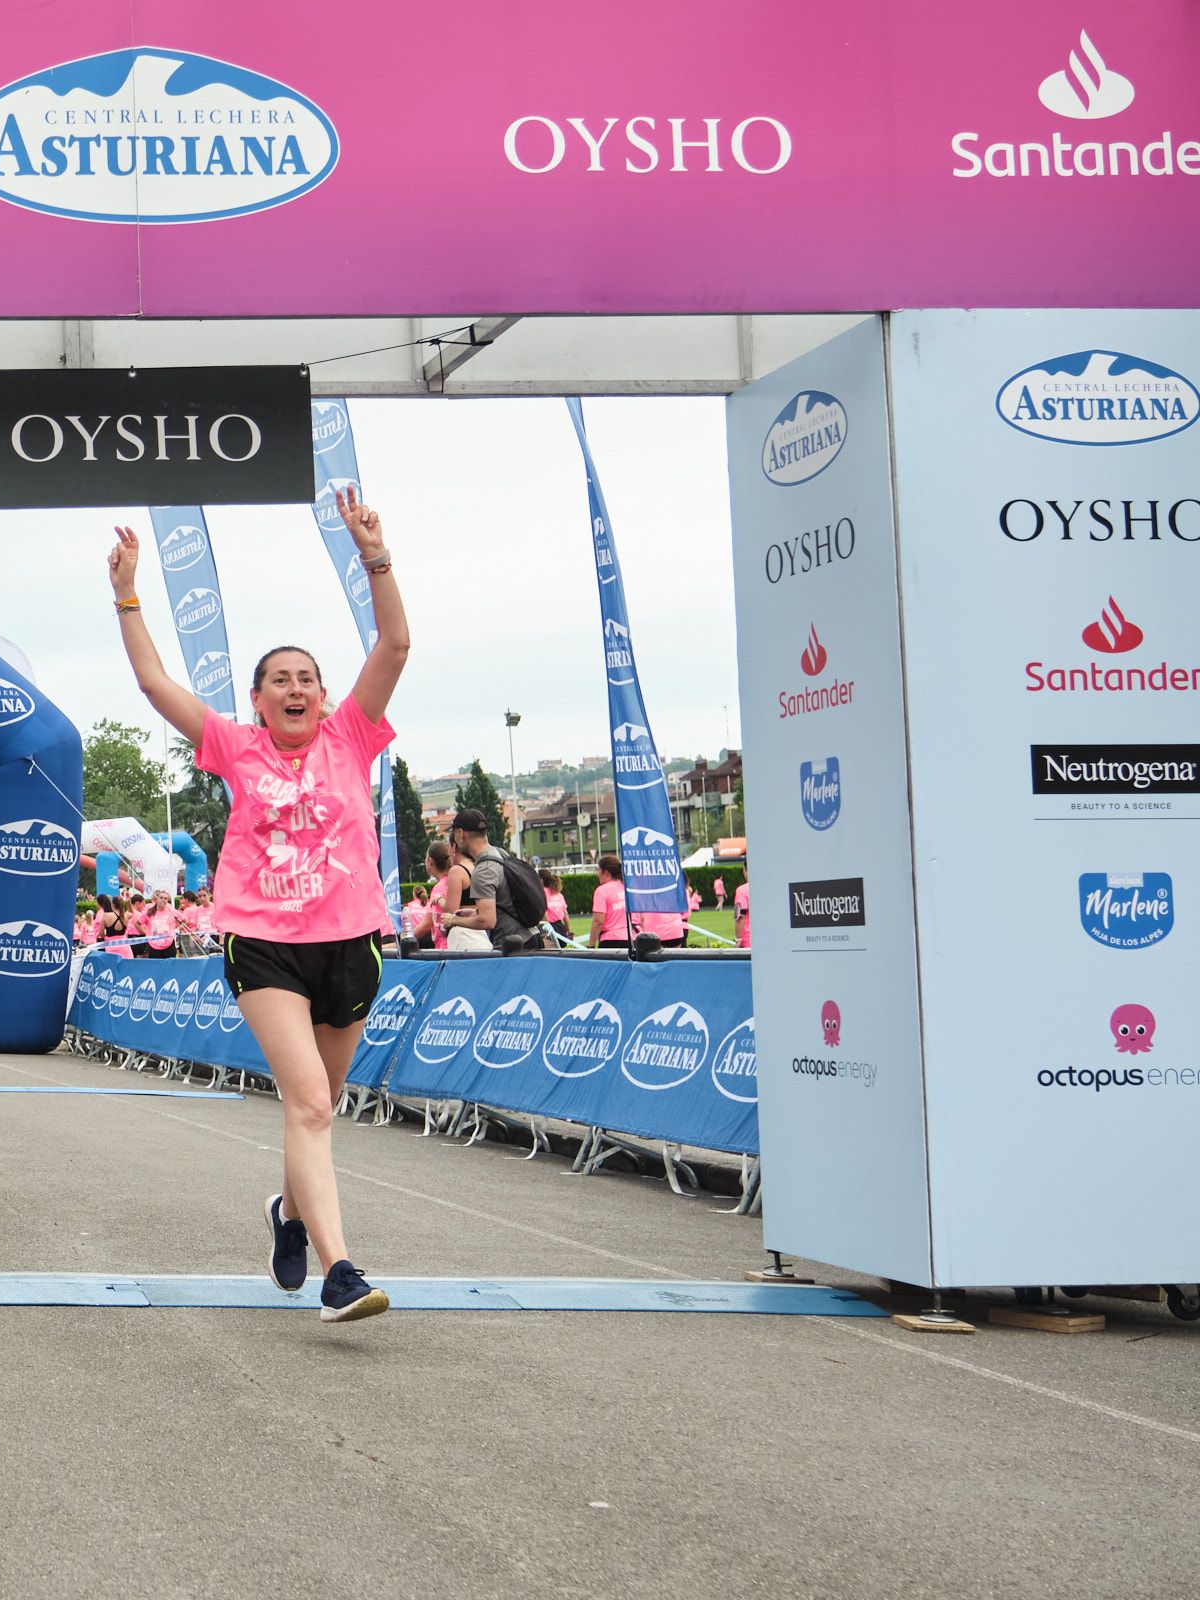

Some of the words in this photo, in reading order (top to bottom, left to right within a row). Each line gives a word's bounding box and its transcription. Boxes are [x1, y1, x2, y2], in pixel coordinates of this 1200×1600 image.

[44, 109, 164, 125] CENTRAL
[176, 109, 296, 125] LECHERA
[503, 115, 793, 174] OYSHO
[951, 131, 1200, 178] Santande
[1012, 385, 1188, 421] ASTURIANA
[1043, 384, 1108, 392] CENTRAL
[1111, 384, 1180, 392] LECHERA
[11, 413, 262, 463] OYSHO
[768, 421, 842, 474] ASTURIANA
[998, 499, 1200, 542] OYSHO
[765, 517, 856, 584] OYSHO
[1026, 661, 1200, 692] Santander
[779, 680, 855, 718] Santander
[615, 753, 661, 773] STURIAN
[1042, 755, 1195, 787] Neutrogena
[803, 774, 838, 813] Marlene
[2, 837, 40, 845] CENTRAL
[623, 858, 676, 877] STURIAN
[259, 873, 324, 899] MUJER
[793, 891, 860, 921] Neutrogena
[1086, 889, 1169, 929] Marlene
[1091, 927, 1108, 942] HIJA
[1110, 937, 1120, 945] DE
[1140, 928, 1164, 944] ALPES
[625, 1031, 698, 1070] ASTURIANA
[793, 1055, 837, 1080] octopus
[838, 1059, 879, 1088] energy
[1037, 1066, 1144, 1091] octopus
[1147, 1068, 1200, 1086] ener
